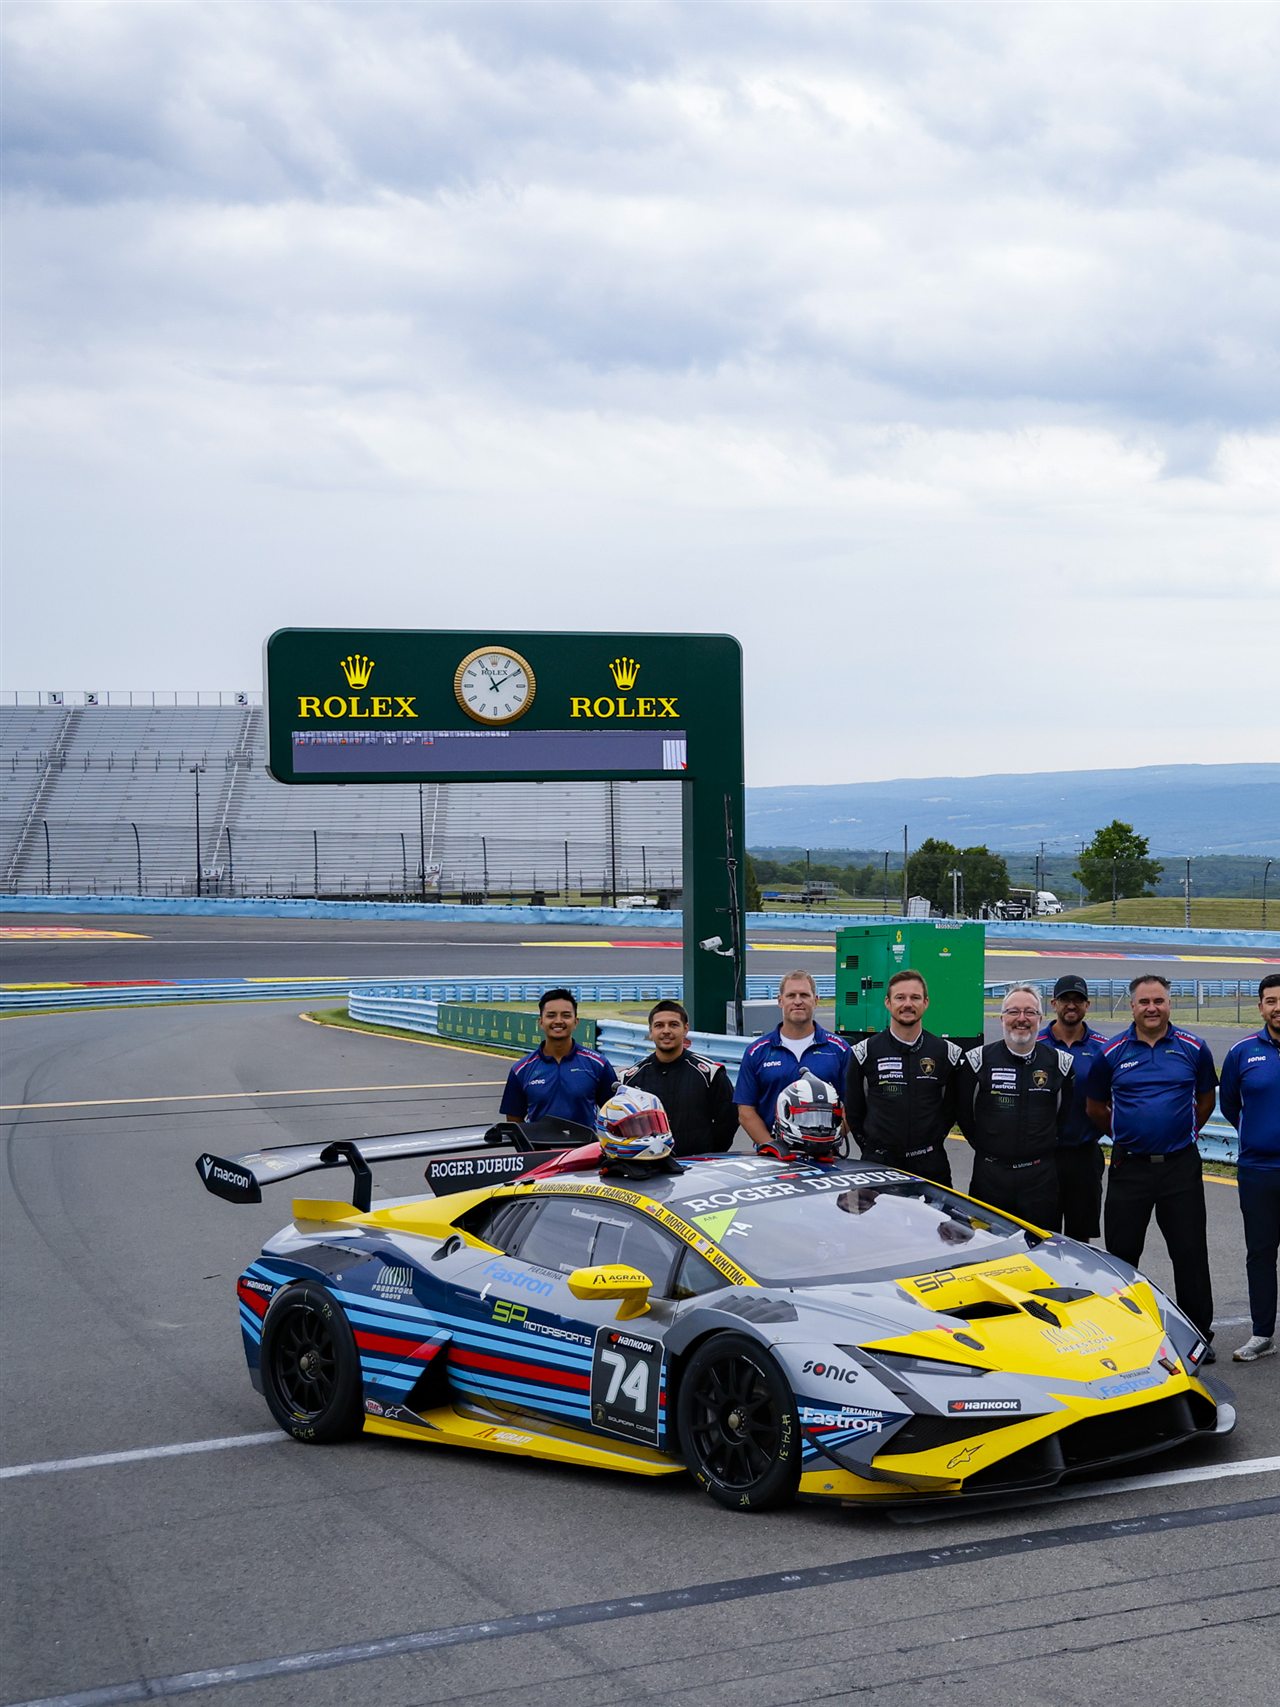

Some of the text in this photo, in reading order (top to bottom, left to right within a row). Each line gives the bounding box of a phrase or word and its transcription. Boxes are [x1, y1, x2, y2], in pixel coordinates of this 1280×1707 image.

[297, 696, 419, 718] ROLEX
[569, 697, 680, 718] ROLEX
[213, 1165, 249, 1189] macron
[430, 1156, 524, 1178] ROGER DUBUIS
[531, 1183, 641, 1205] LAMBORGHINI SAN FRANCISCO
[683, 1168, 911, 1213] ROGER DUBUIS
[663, 1213, 697, 1242] MORILLO
[725, 1220, 753, 1237] 74
[481, 1261, 555, 1297] Fastron
[711, 1251, 747, 1286] WHITING
[913, 1271, 956, 1293] SP
[491, 1300, 592, 1346] SP MOTORSPORTS
[601, 1348, 649, 1413] 74
[1100, 1375, 1159, 1398] Fastron
[803, 1406, 882, 1433] Fastron
[841, 1406, 884, 1418] PERTAMINA
[493, 1431, 533, 1444] AGRATI
